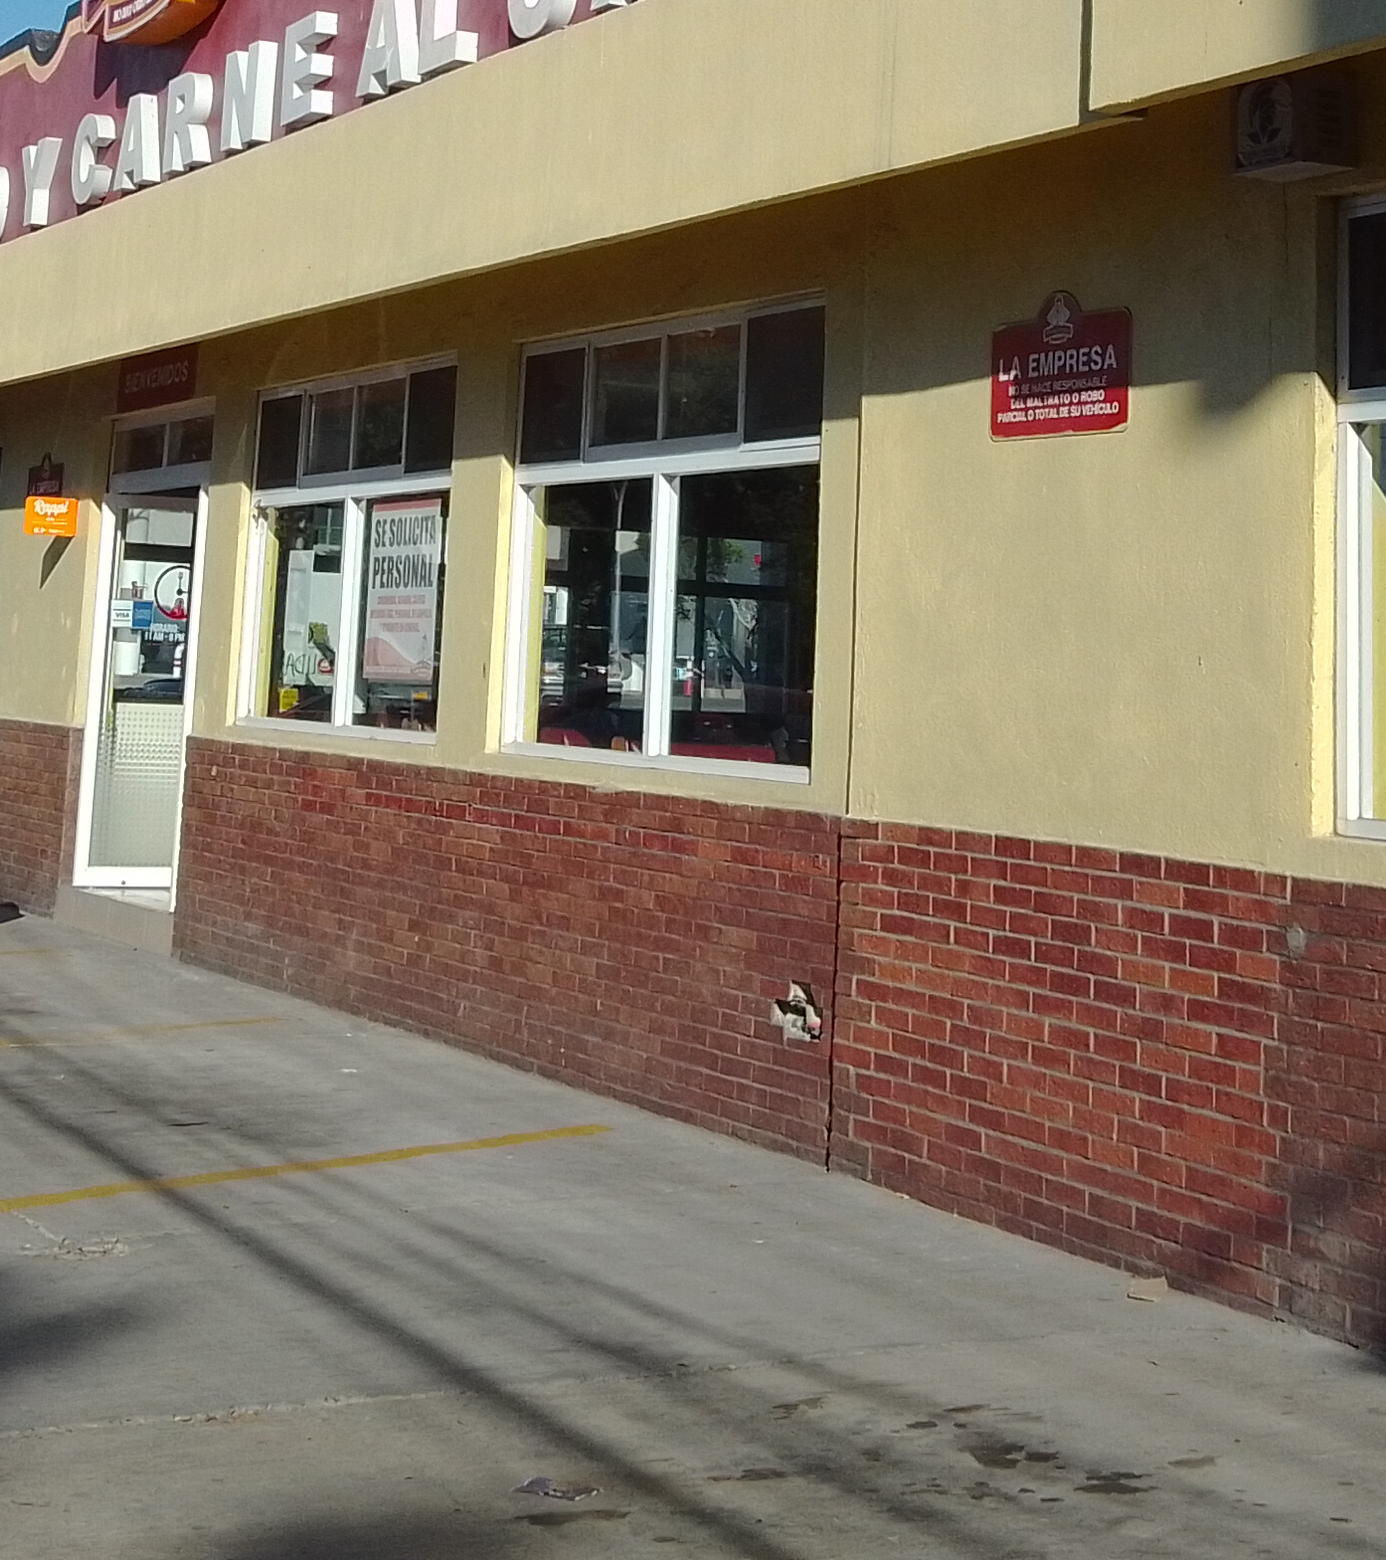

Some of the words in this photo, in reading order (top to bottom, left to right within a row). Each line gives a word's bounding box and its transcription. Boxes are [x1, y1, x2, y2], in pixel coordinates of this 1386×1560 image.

[21, 137, 63, 228] Y
[71, 11, 338, 205] CARNE
[998, 354, 1021, 382] LA
[1027, 342, 1117, 378] EMPRESA
[1033, 405, 1058, 419] TOTAL
[1069, 402, 1080, 415] SU
[1079, 387, 1104, 401] ROBO
[374, 517, 387, 548] SE
[388, 515, 436, 548] SOLICITA
[371, 553, 434, 589] PERSONAL
